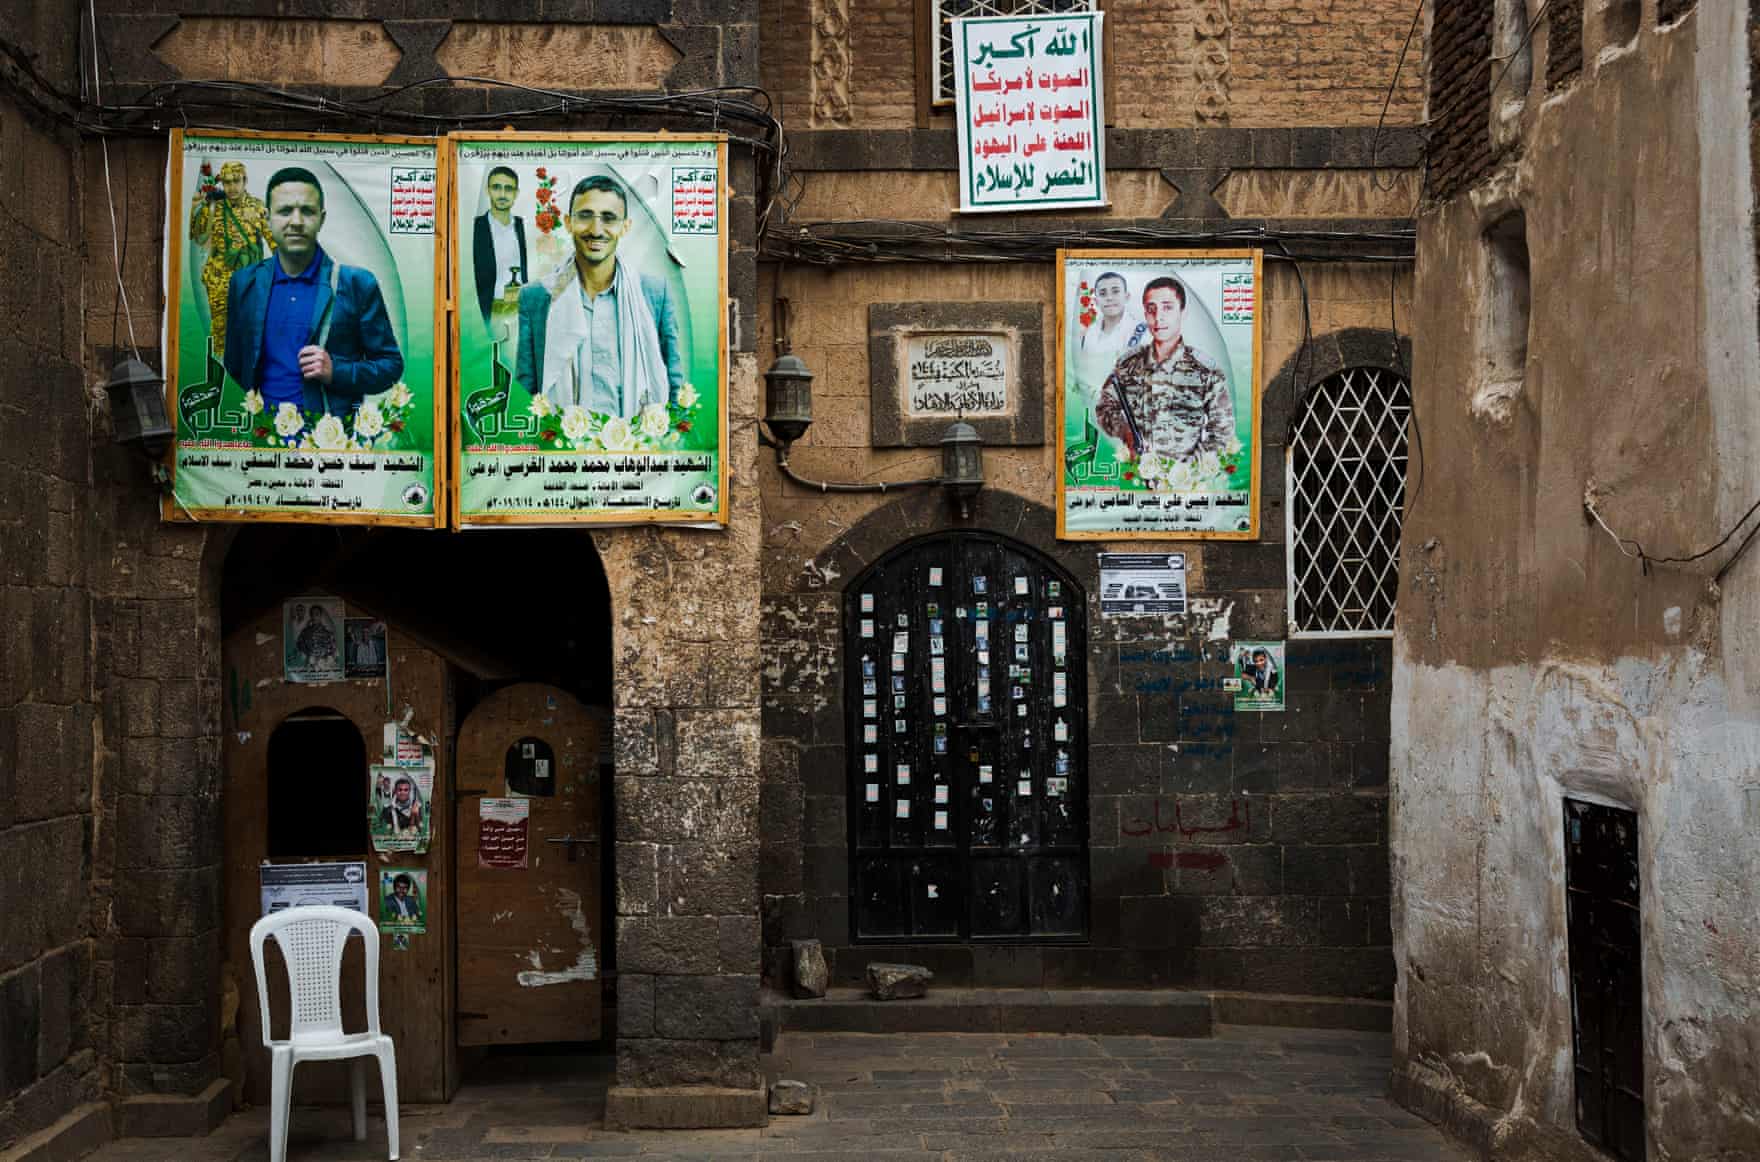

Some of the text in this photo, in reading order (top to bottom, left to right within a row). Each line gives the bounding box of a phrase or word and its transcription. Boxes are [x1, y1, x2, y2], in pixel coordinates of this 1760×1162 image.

[969, 24, 1088, 68] الله أكبر
[1038, 68, 1088, 92] الموت
[1040, 100, 1088, 123] الموت
[975, 131, 1091, 158] اللعنة على اليهود
[1041, 157, 1093, 194] النصر
[673, 456, 712, 476] الشهيد
